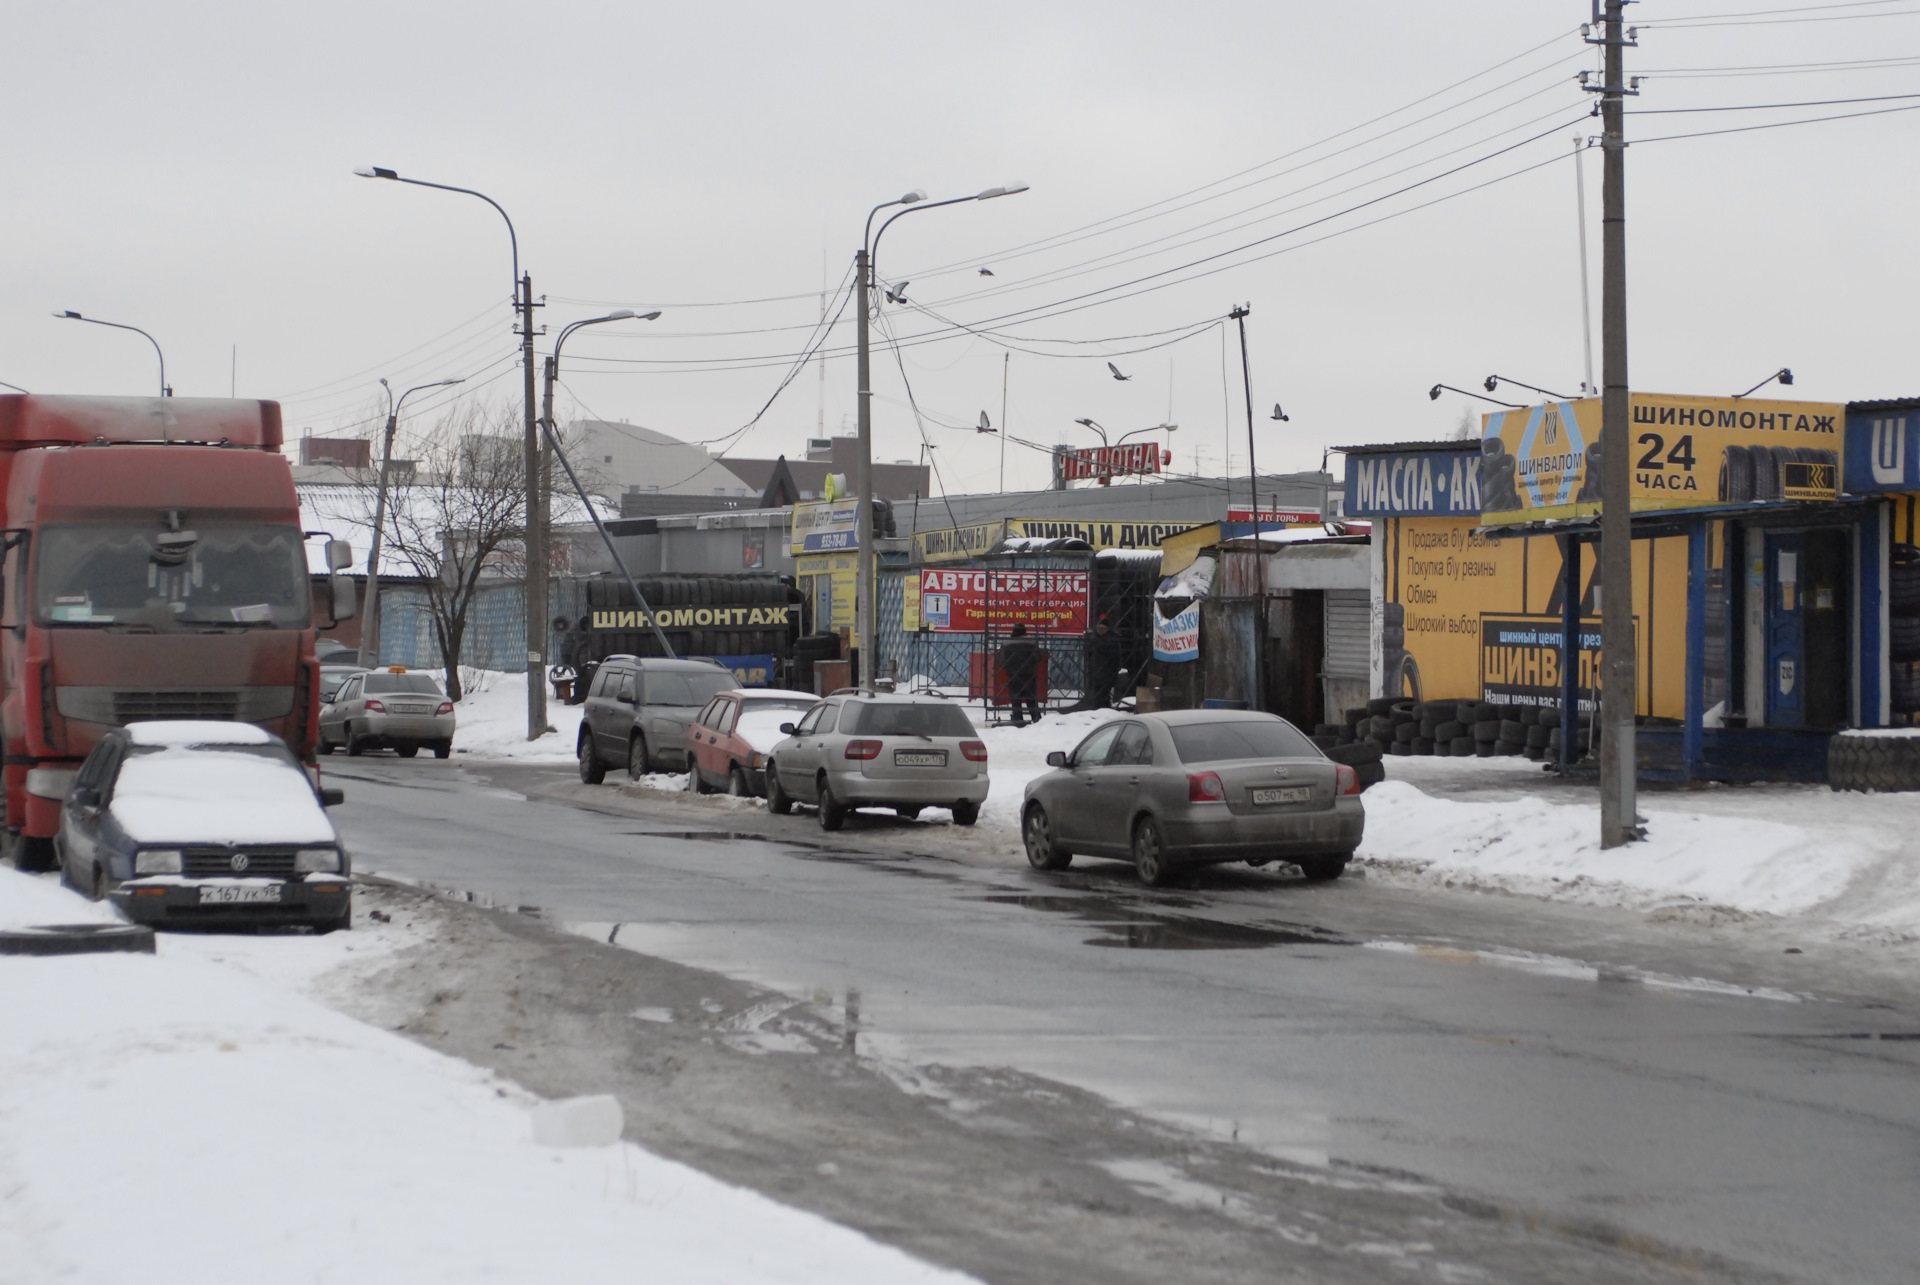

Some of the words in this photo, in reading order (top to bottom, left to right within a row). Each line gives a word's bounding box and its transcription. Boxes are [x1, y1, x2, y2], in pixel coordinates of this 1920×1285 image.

[1633, 405, 1836, 433] ШИНОМОНТАЖ
[1636, 433, 1697, 471] 24
[1871, 417, 1920, 485] Ш
[1518, 452, 1582, 476] ШИНВАЛОМ
[1357, 457, 1434, 512] МАСЛА
[1636, 472, 1698, 491] ЧАСА
[1784, 489, 1836, 499] ШИНВАЛОМ
[1022, 522, 1095, 546] ШИНЫ
[1100, 523, 1113, 547] И
[1408, 528, 1449, 552] Продажа
[1407, 557, 1444, 581] Покупка
[1462, 562, 1497, 581] резины
[924, 572, 1088, 593] АВТОСЕРВИС
[953, 598, 966, 606] ТО
[1407, 584, 1437, 604] Обмен
[593, 607, 789, 628] ШИНОМОНТАЖ
[965, 609, 1014, 619] Гарантия
[1406, 612, 1446, 637] Широкий
[1448, 614, 1478, 639] выбор
[1500, 629, 1537, 643] шинный
[1583, 634, 1602, 649] рез
[1484, 689, 1511, 705] Наши
